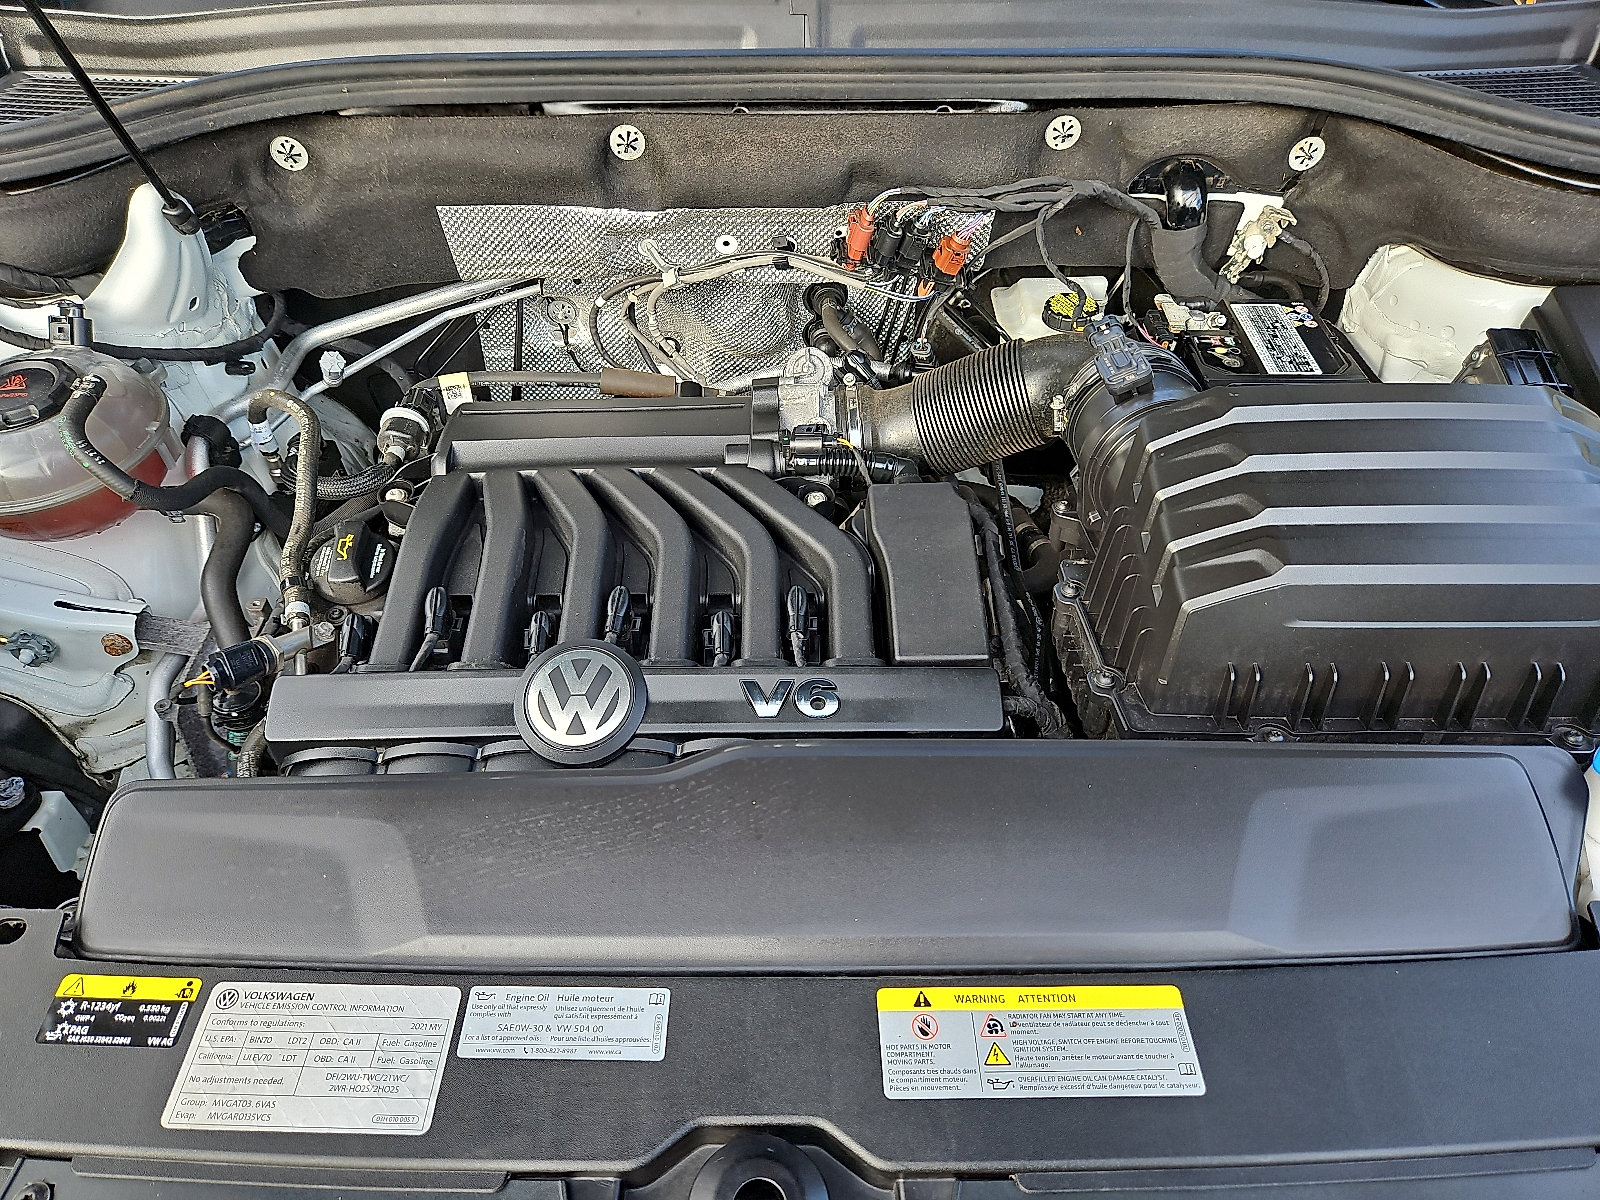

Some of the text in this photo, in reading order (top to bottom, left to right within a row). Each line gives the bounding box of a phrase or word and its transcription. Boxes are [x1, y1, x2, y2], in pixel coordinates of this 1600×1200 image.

[739, 678, 841, 719] V6
[244, 991, 315, 1000] VOLKSWAGEN
[506, 994, 535, 1003] Engine
[557, 994, 579, 1002] Huile
[954, 994, 1077, 1004] WARNING ATTENTION
[80, 1001, 122, 1013] R-1234yf
[272, 1002, 310, 1010] EMISSION
[350, 1004, 405, 1012] INFORMATION
[211, 1018, 248, 1026] Conforms
[260, 1020, 305, 1028] regulations:
[68, 1025, 90, 1035] PAG
[147, 1037, 174, 1046] VW AG
[404, 1040, 437, 1048] Gasoline
[314, 1055, 333, 1063] OBD:
[400, 1057, 433, 1065] Gasoline
[202, 1076, 251, 1085] adjustments
[253, 1077, 284, 1085] needed.
[896, 1077, 942, 1085] compartiment
[181, 1098, 207, 1108] Group:
[176, 1112, 196, 1121] Evap:
